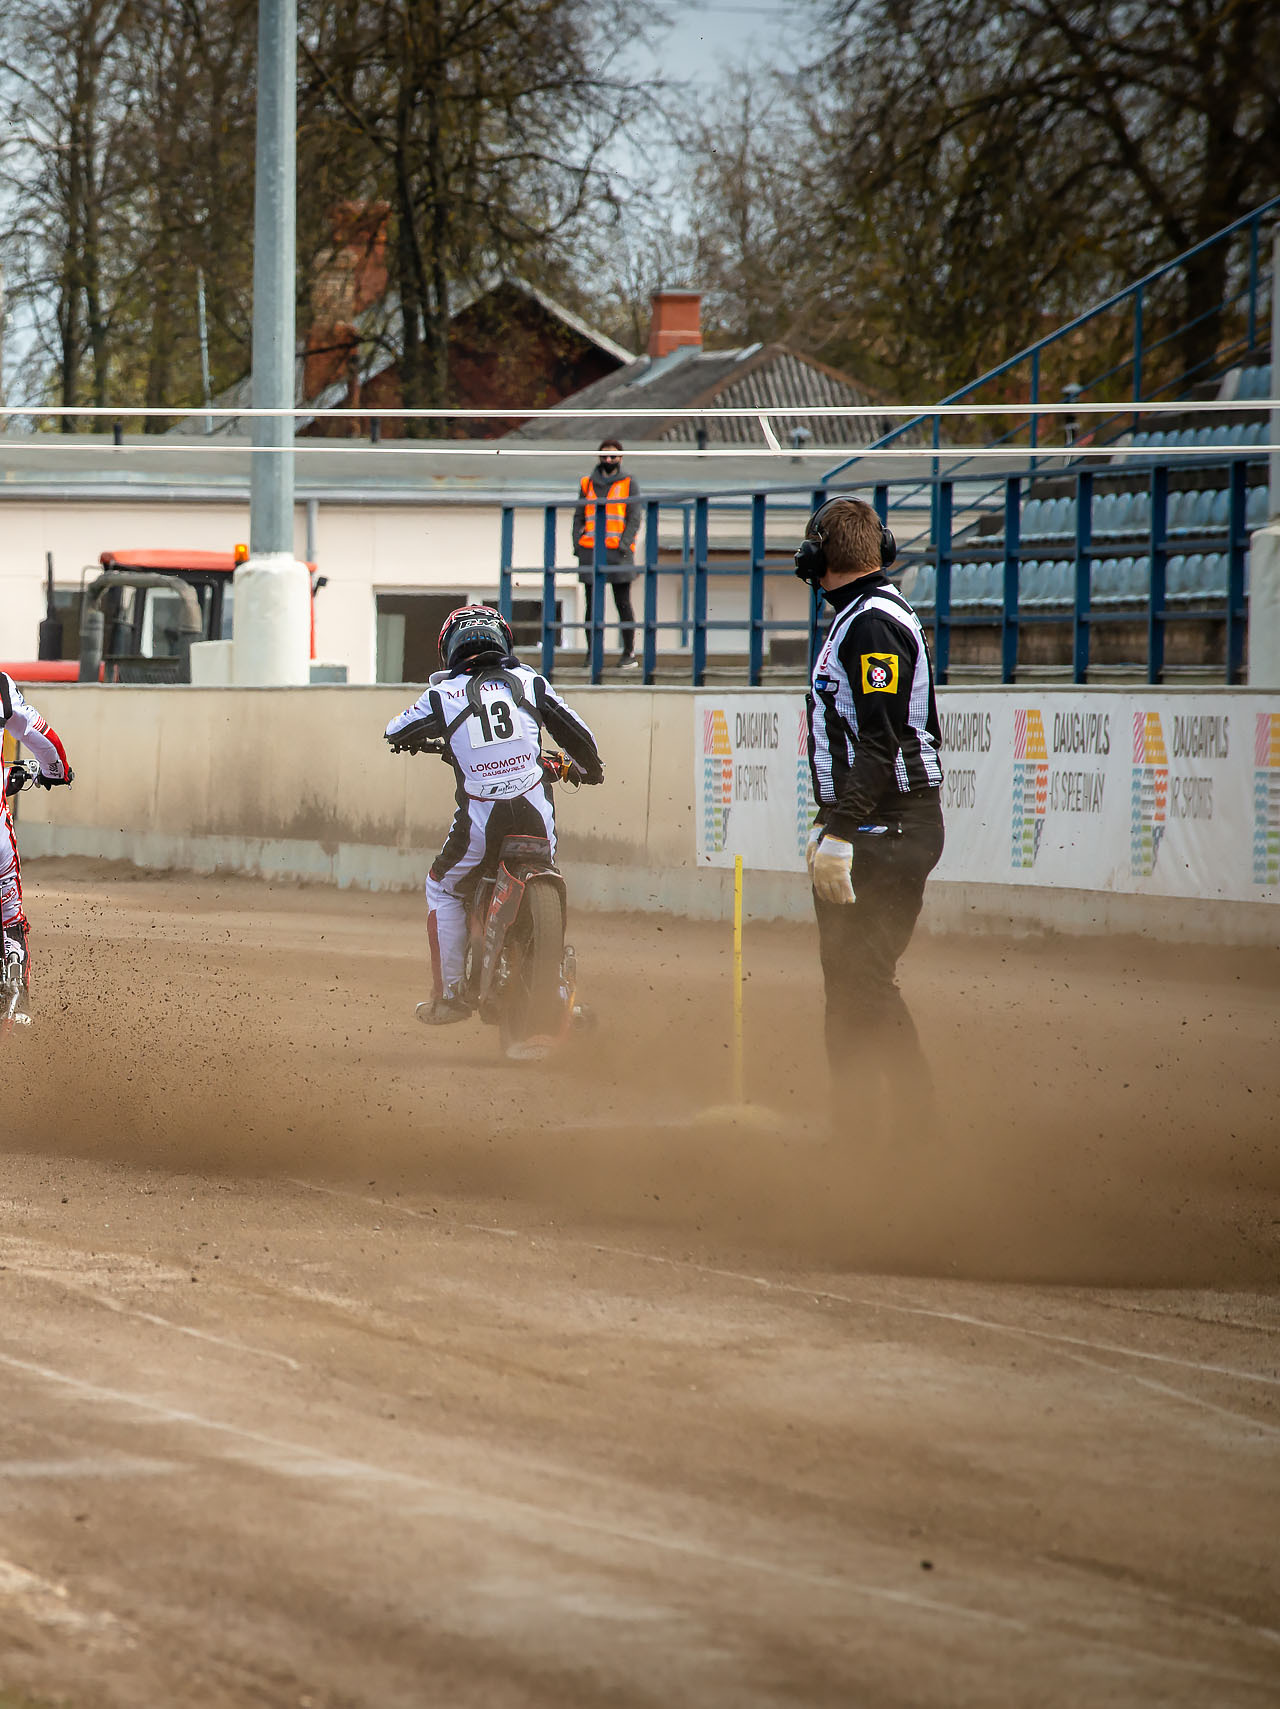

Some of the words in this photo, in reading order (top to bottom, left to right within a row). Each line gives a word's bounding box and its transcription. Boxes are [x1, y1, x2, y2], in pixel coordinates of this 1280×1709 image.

[473, 701, 514, 742] 13
[1053, 712, 1111, 755] DAUGAVPILS
[1173, 715, 1230, 759] DAUGAVPILS
[470, 753, 532, 772] LOKOMOTIV
[947, 769, 977, 809] SPORTS
